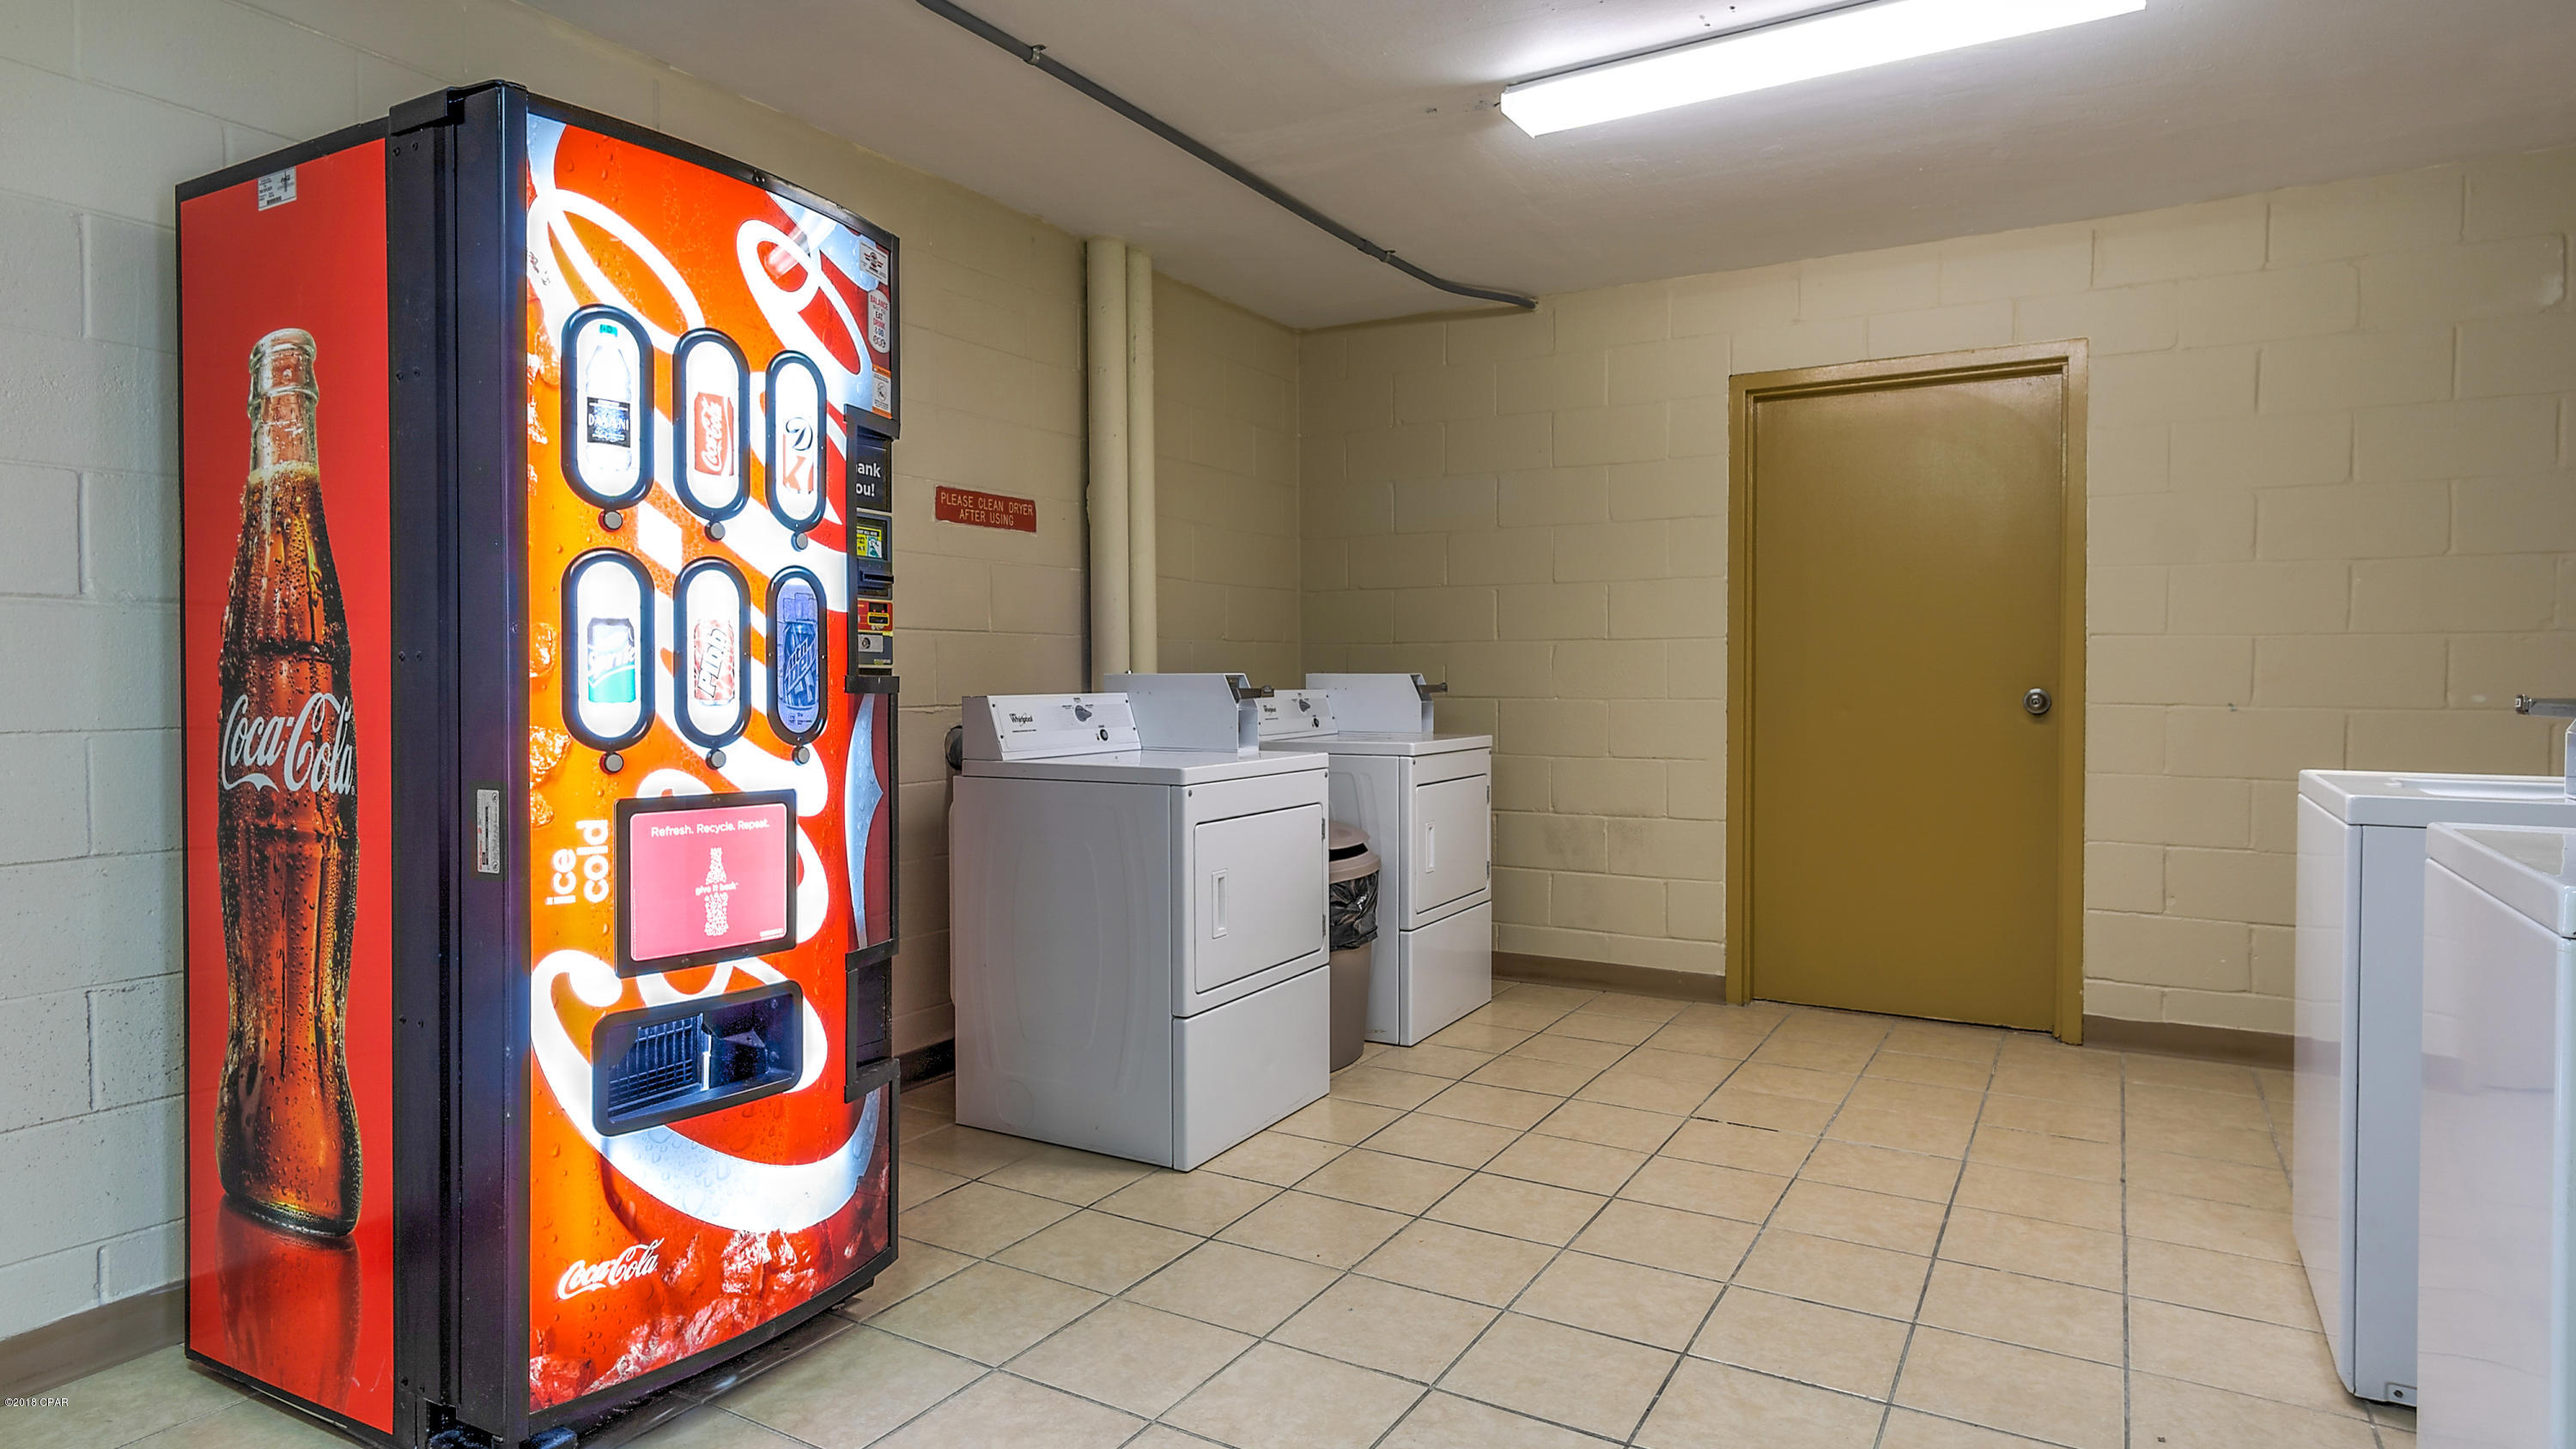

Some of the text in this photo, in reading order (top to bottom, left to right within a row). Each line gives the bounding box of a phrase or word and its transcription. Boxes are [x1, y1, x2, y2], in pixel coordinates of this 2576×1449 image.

[856, 462, 881, 477] ank
[856, 483, 875, 496] ou!
[940, 492, 1033, 515] PLEASE CLEAN DRYER
[959, 509, 1014, 526] AFTER USING
[1009, 712, 1034, 727] Whirlpool
[222, 692, 353, 795] Coca-Cola
[651, 818, 770, 838] Refresh. Recycle. Repeat.
[575, 819, 610, 904] cold
[544, 848, 577, 906] ice
[696, 885, 712, 895] give
[557, 1237, 665, 1300] Coca-Cola
